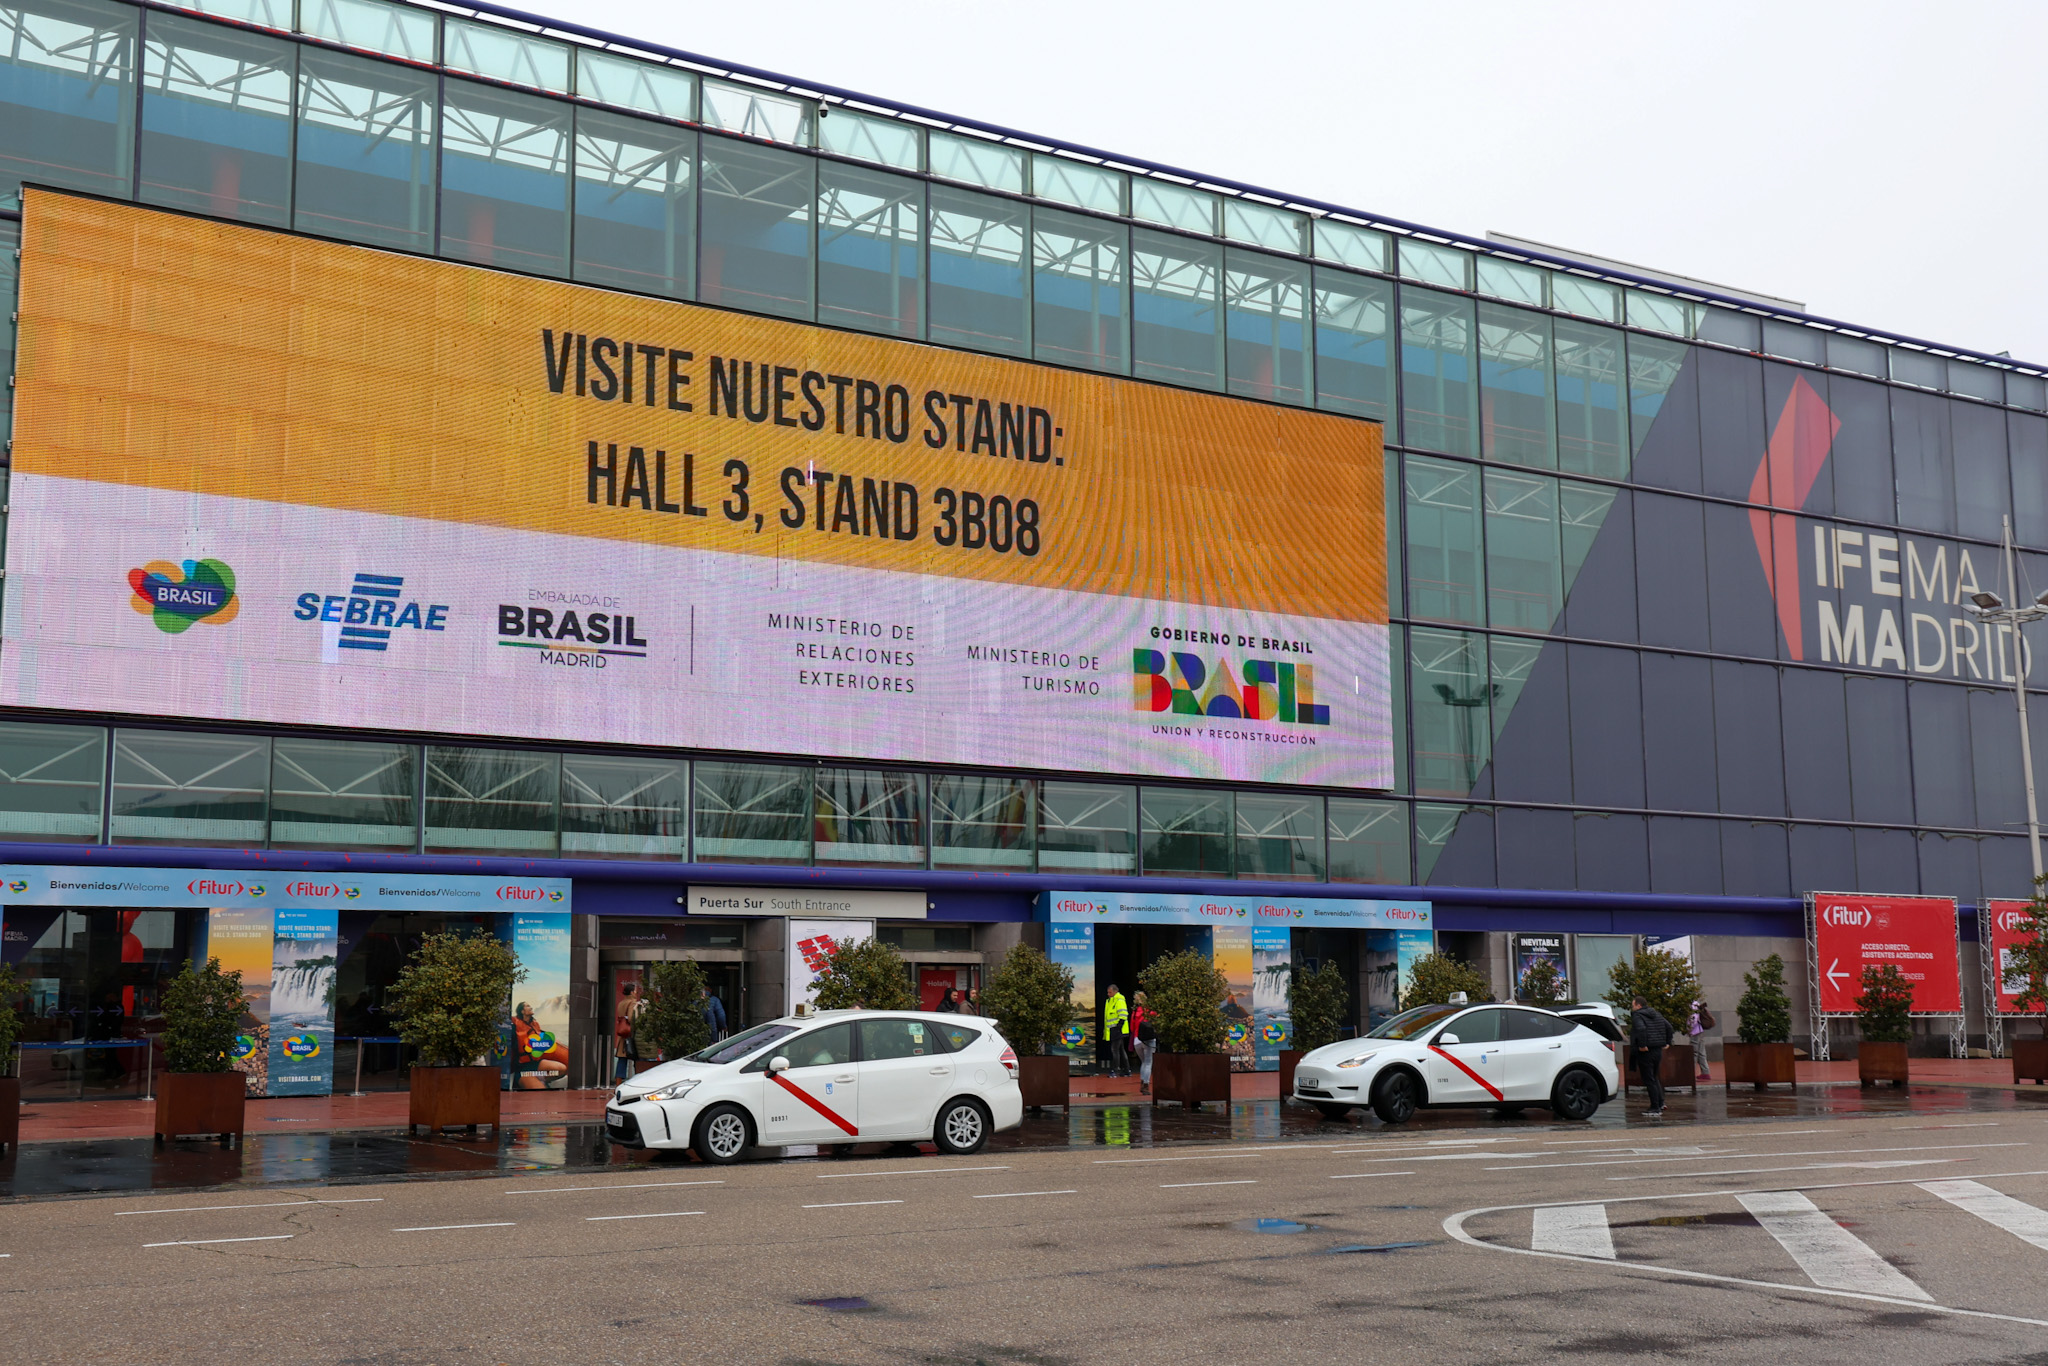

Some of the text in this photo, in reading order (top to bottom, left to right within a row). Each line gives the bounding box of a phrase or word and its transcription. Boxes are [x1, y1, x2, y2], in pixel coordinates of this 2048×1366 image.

[543, 328, 1064, 466] VISITE NUESTRO STAND:
[587, 440, 1041, 557] HALL 3, STAND 3B08
[1813, 525, 1985, 606] IFEMA
[157, 586, 218, 606] BRASIL
[528, 588, 621, 609] EMBAJADA DE
[293, 592, 449, 632] SEBRAE
[498, 604, 647, 647] BRASIL
[768, 613, 915, 641] MINISTERIO DE
[1150, 626, 1313, 654] GOBIERNO DE BRASIL
[1817, 600, 2032, 683] MADRID
[540, 650, 607, 669] MADRID
[796, 642, 915, 667] RELACIONES
[967, 645, 1099, 671] MINISTERIO DE
[799, 670, 915, 693] EXTERIORES
[1022, 676, 1100, 696] TURISMO
[1133, 648, 1330, 725] BRASIL
[1197, 728, 1204, 738] Y
[50, 879, 170, 892] Bienvenidos/Welcome
[379, 887, 481, 898] Bienvenidos/Welcome
[700, 897, 851, 912] Puerta Sur South Entrance
[1520, 938, 1560, 947] INEVITABLE
[1884, 943, 1910, 951] DIRECTO:
[1861, 951, 1934, 960] ASISTENTES ACREDITADOS
